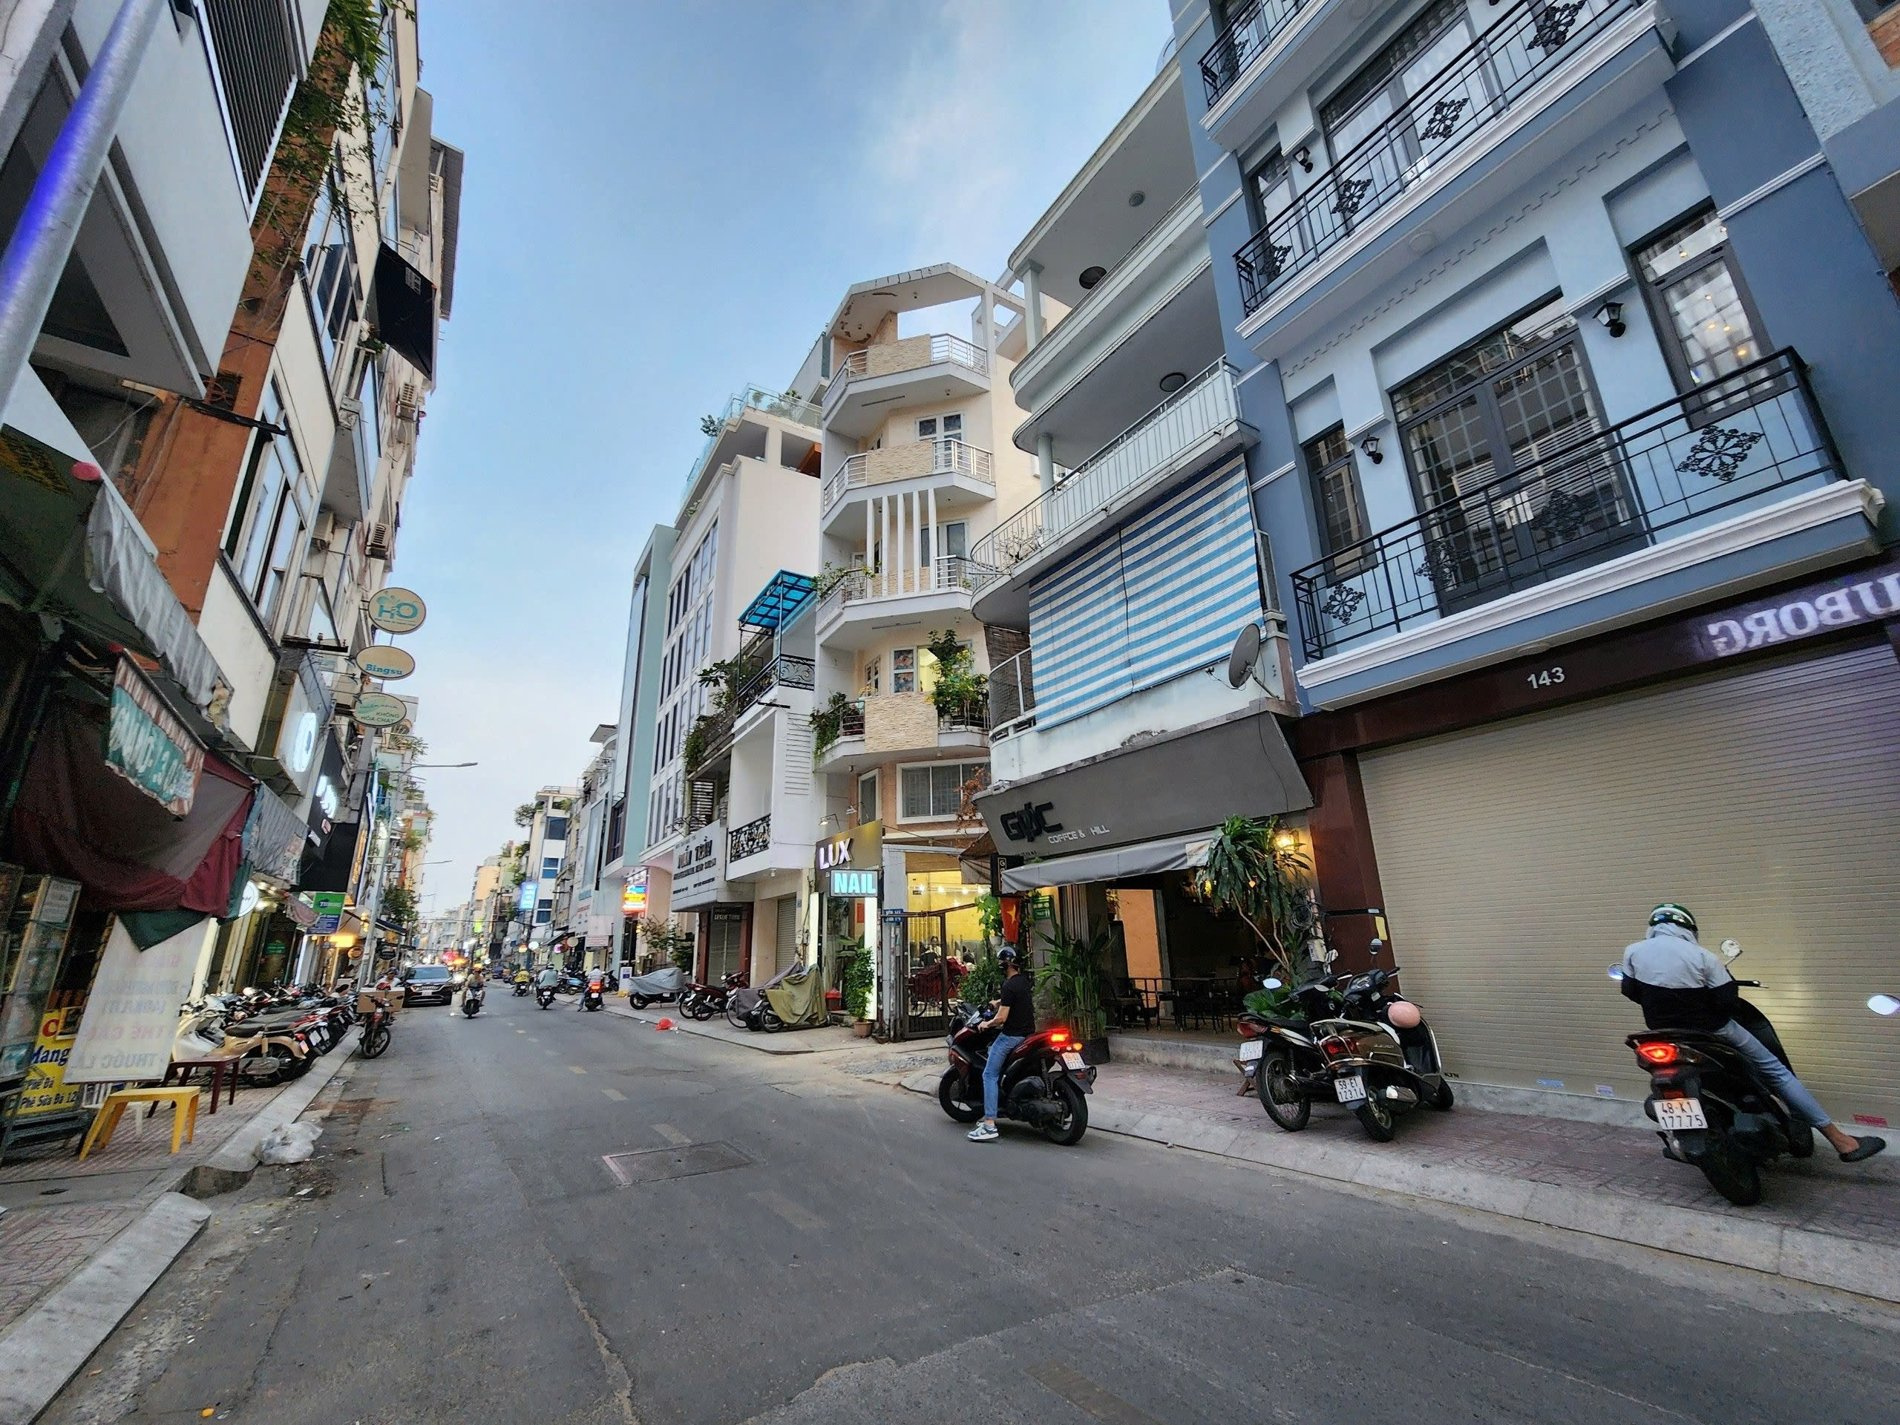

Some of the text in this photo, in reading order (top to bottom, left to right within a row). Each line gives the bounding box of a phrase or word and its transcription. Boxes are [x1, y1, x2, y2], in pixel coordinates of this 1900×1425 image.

[366, 663, 403, 676] Bingsu
[1527, 667, 1565, 689] 143
[1090, 824, 1111, 836] HILL
[819, 838, 852, 870] LUX
[834, 872, 877, 894] NAIL
[1661, 1101, 1694, 1114] 48-K1
[1661, 1115, 1704, 1128] 177.75
